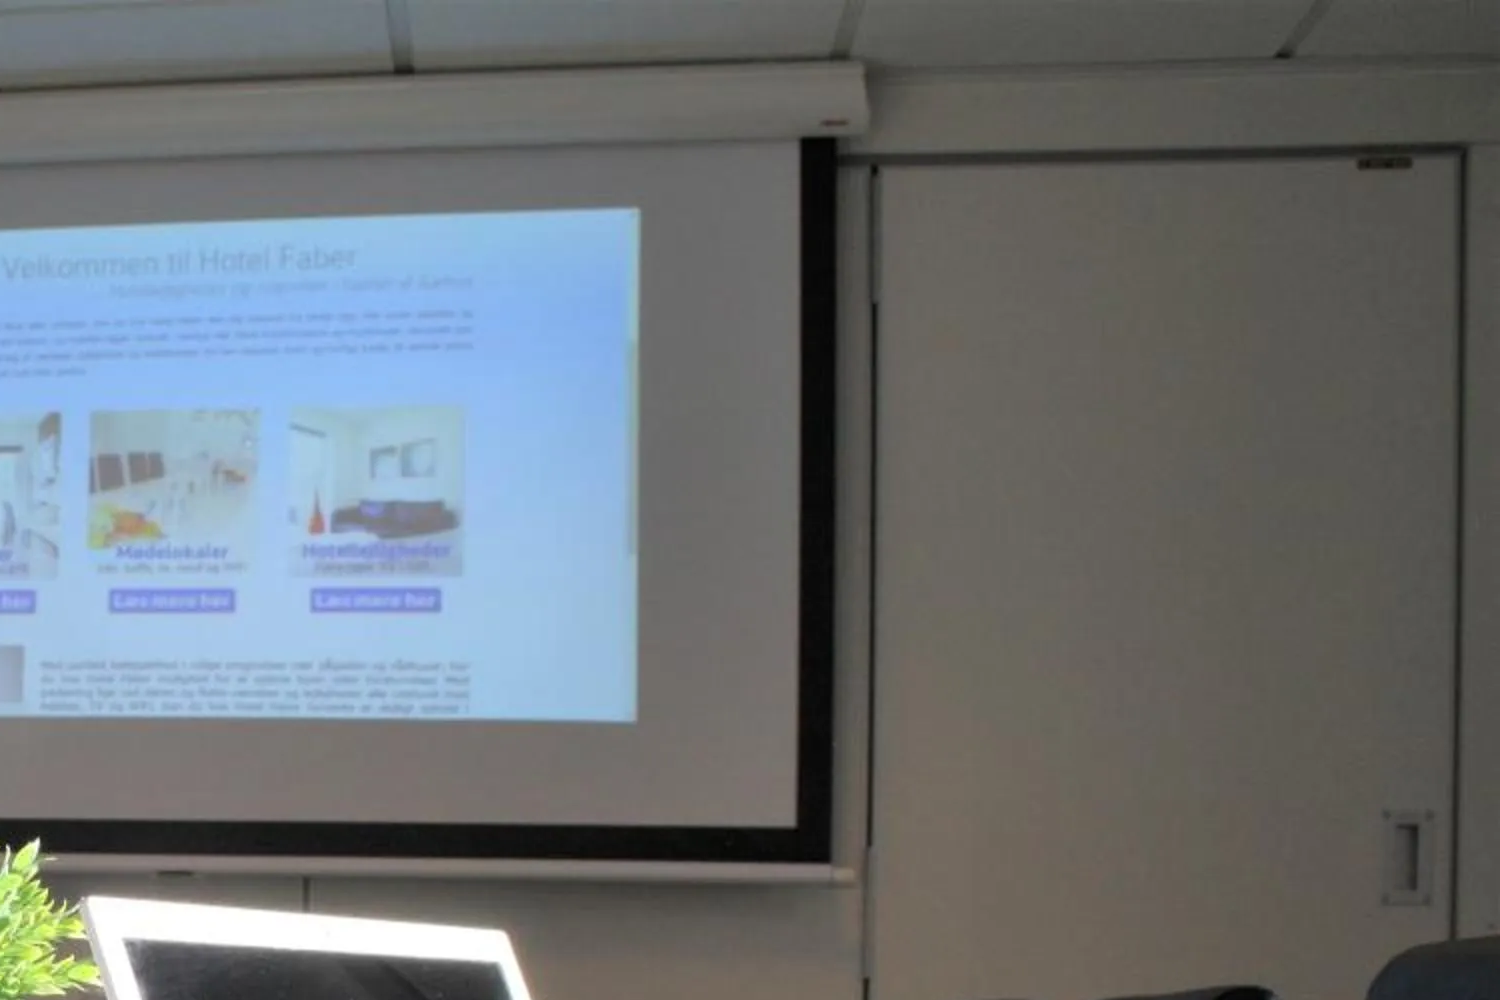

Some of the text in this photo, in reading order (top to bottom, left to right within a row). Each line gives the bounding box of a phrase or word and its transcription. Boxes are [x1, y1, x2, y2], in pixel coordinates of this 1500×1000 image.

[2, 243, 358, 280] Velkommen til Hotel Faber
[152, 592, 197, 609] mere
[199, 592, 229, 609] her
[353, 592, 401, 609] mere
[404, 592, 436, 609] her
